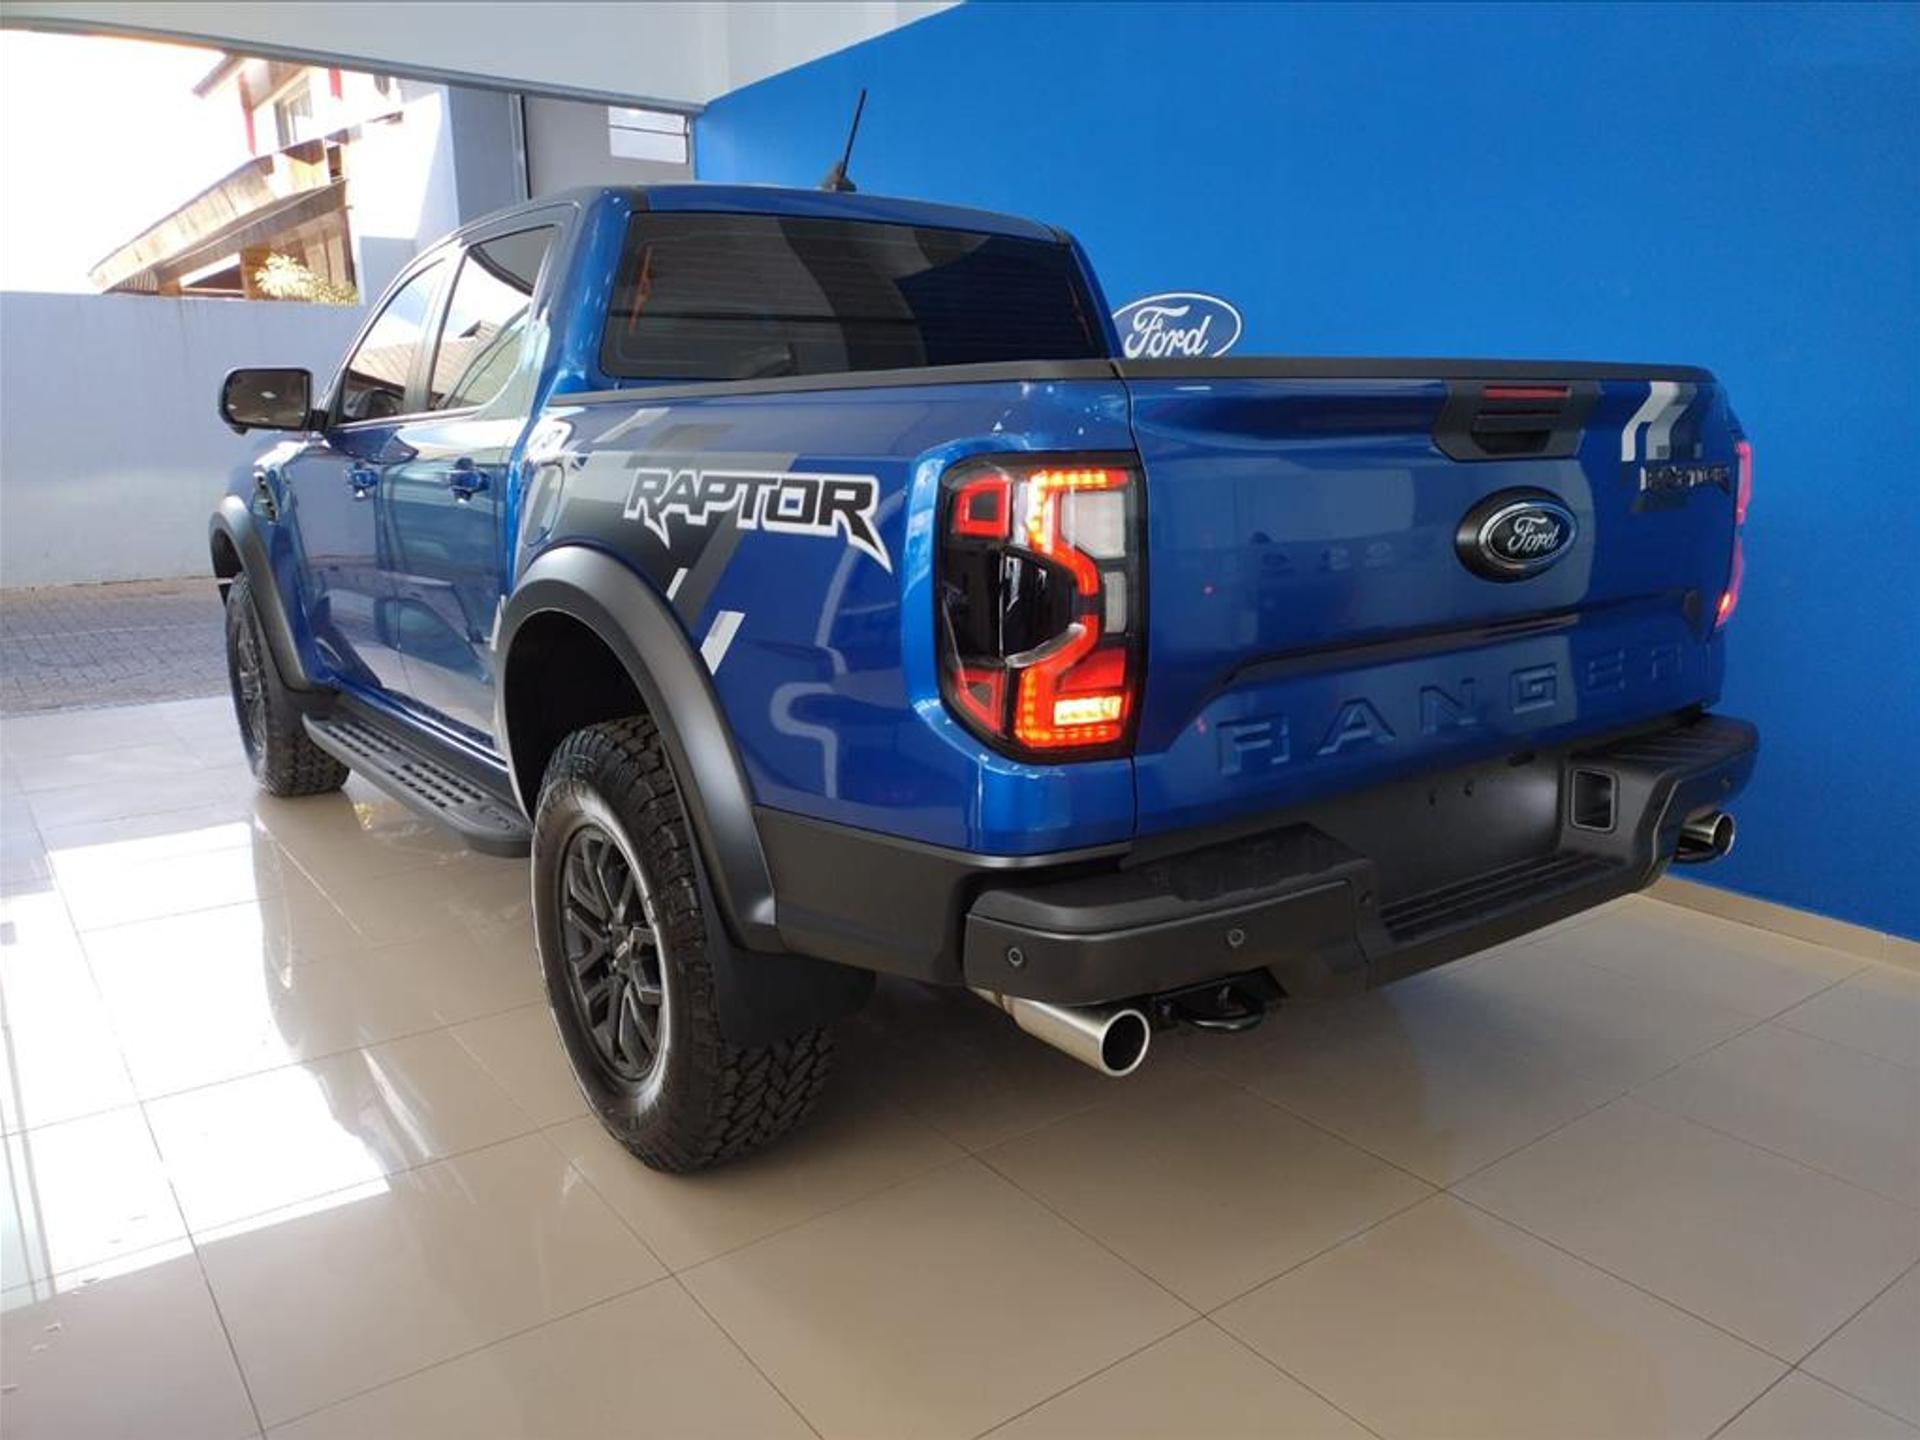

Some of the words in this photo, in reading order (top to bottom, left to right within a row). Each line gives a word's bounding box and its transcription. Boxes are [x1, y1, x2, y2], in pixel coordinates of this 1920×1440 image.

[1124, 304, 1213, 359] Ford
[623, 468, 893, 574] RAPTOR
[1507, 516, 1560, 552] Ford
